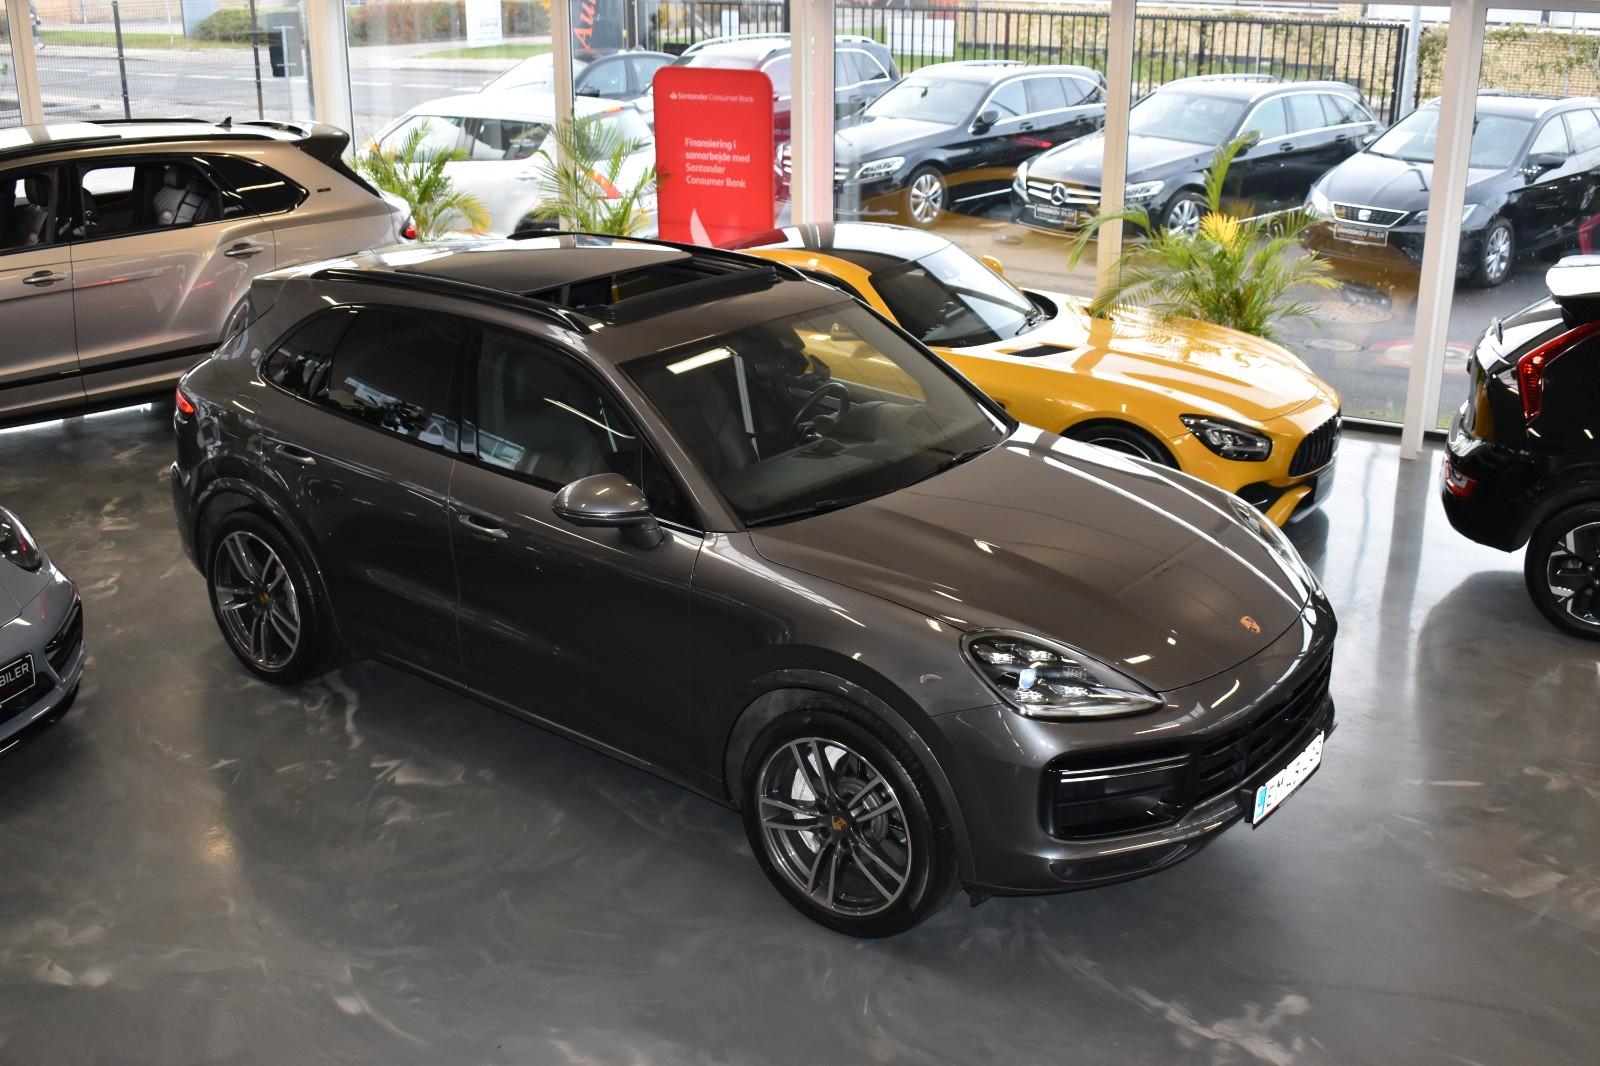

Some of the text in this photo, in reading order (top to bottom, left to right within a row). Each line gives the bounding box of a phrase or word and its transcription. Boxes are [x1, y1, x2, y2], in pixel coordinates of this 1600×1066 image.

[573, 0, 596, 49] Au
[678, 92, 754, 103] Santander Consumer Bank
[685, 137, 732, 151] Finansiering
[685, 152, 751, 163] samarbejde med
[686, 162, 726, 174] Santander
[686, 175, 746, 189] Consumer Bank
[0, 662, 30, 687] BILER
